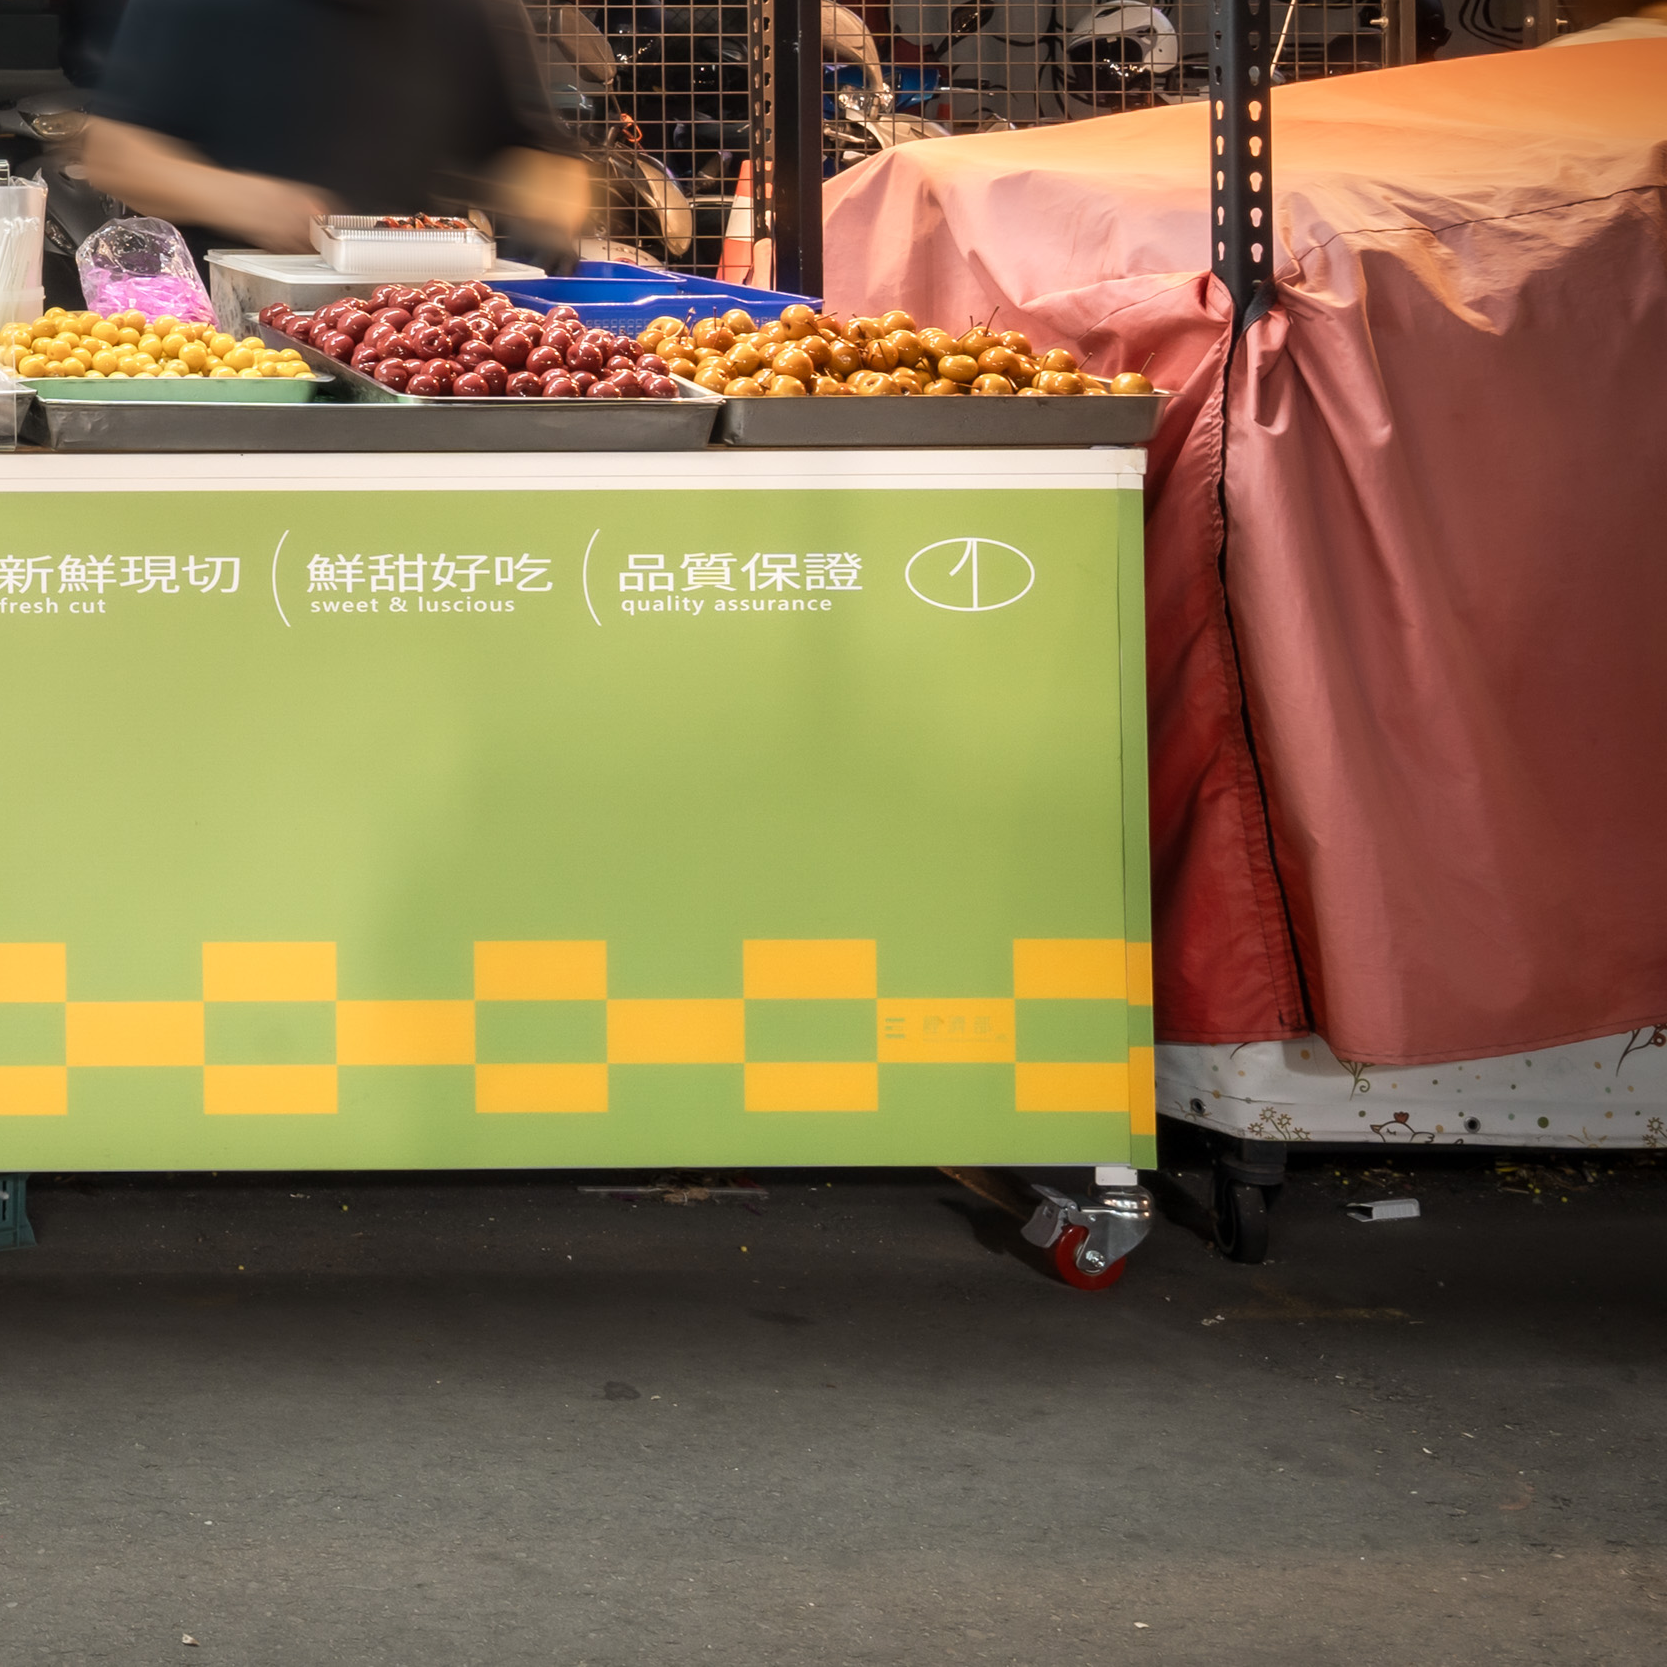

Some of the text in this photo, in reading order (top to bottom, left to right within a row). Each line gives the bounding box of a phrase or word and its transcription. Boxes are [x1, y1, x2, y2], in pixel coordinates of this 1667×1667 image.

[306, 553, 553, 594] 鮮甜好吃
[619, 552, 863, 592] 品質保證
[0, 597, 107, 614] fresh cut
[310, 596, 515, 614] sweet & luscious
[621, 595, 832, 616] quality assurance
